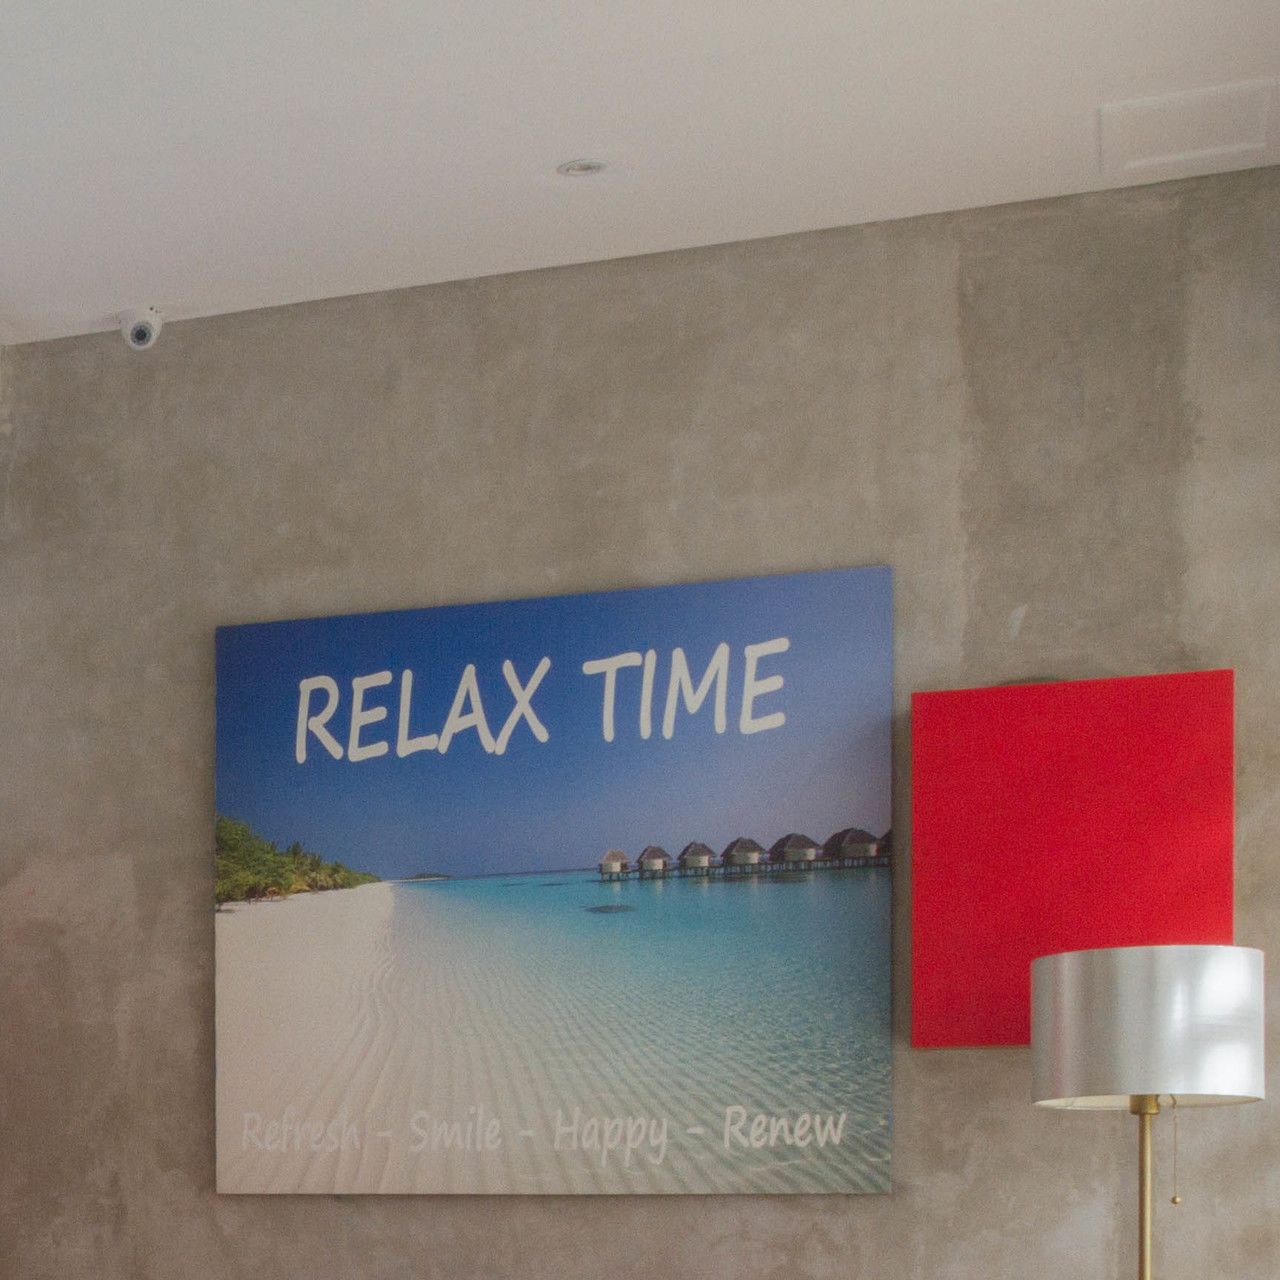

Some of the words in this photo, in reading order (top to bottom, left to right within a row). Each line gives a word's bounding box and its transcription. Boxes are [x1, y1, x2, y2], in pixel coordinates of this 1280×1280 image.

[295, 656, 551, 764] RELAX
[583, 637, 790, 741] TIME
[242, 1104, 360, 1152] Refresh
[409, 1104, 502, 1152] Smile
[554, 1106, 668, 1168] Happy
[724, 1105, 848, 1148] Renew
